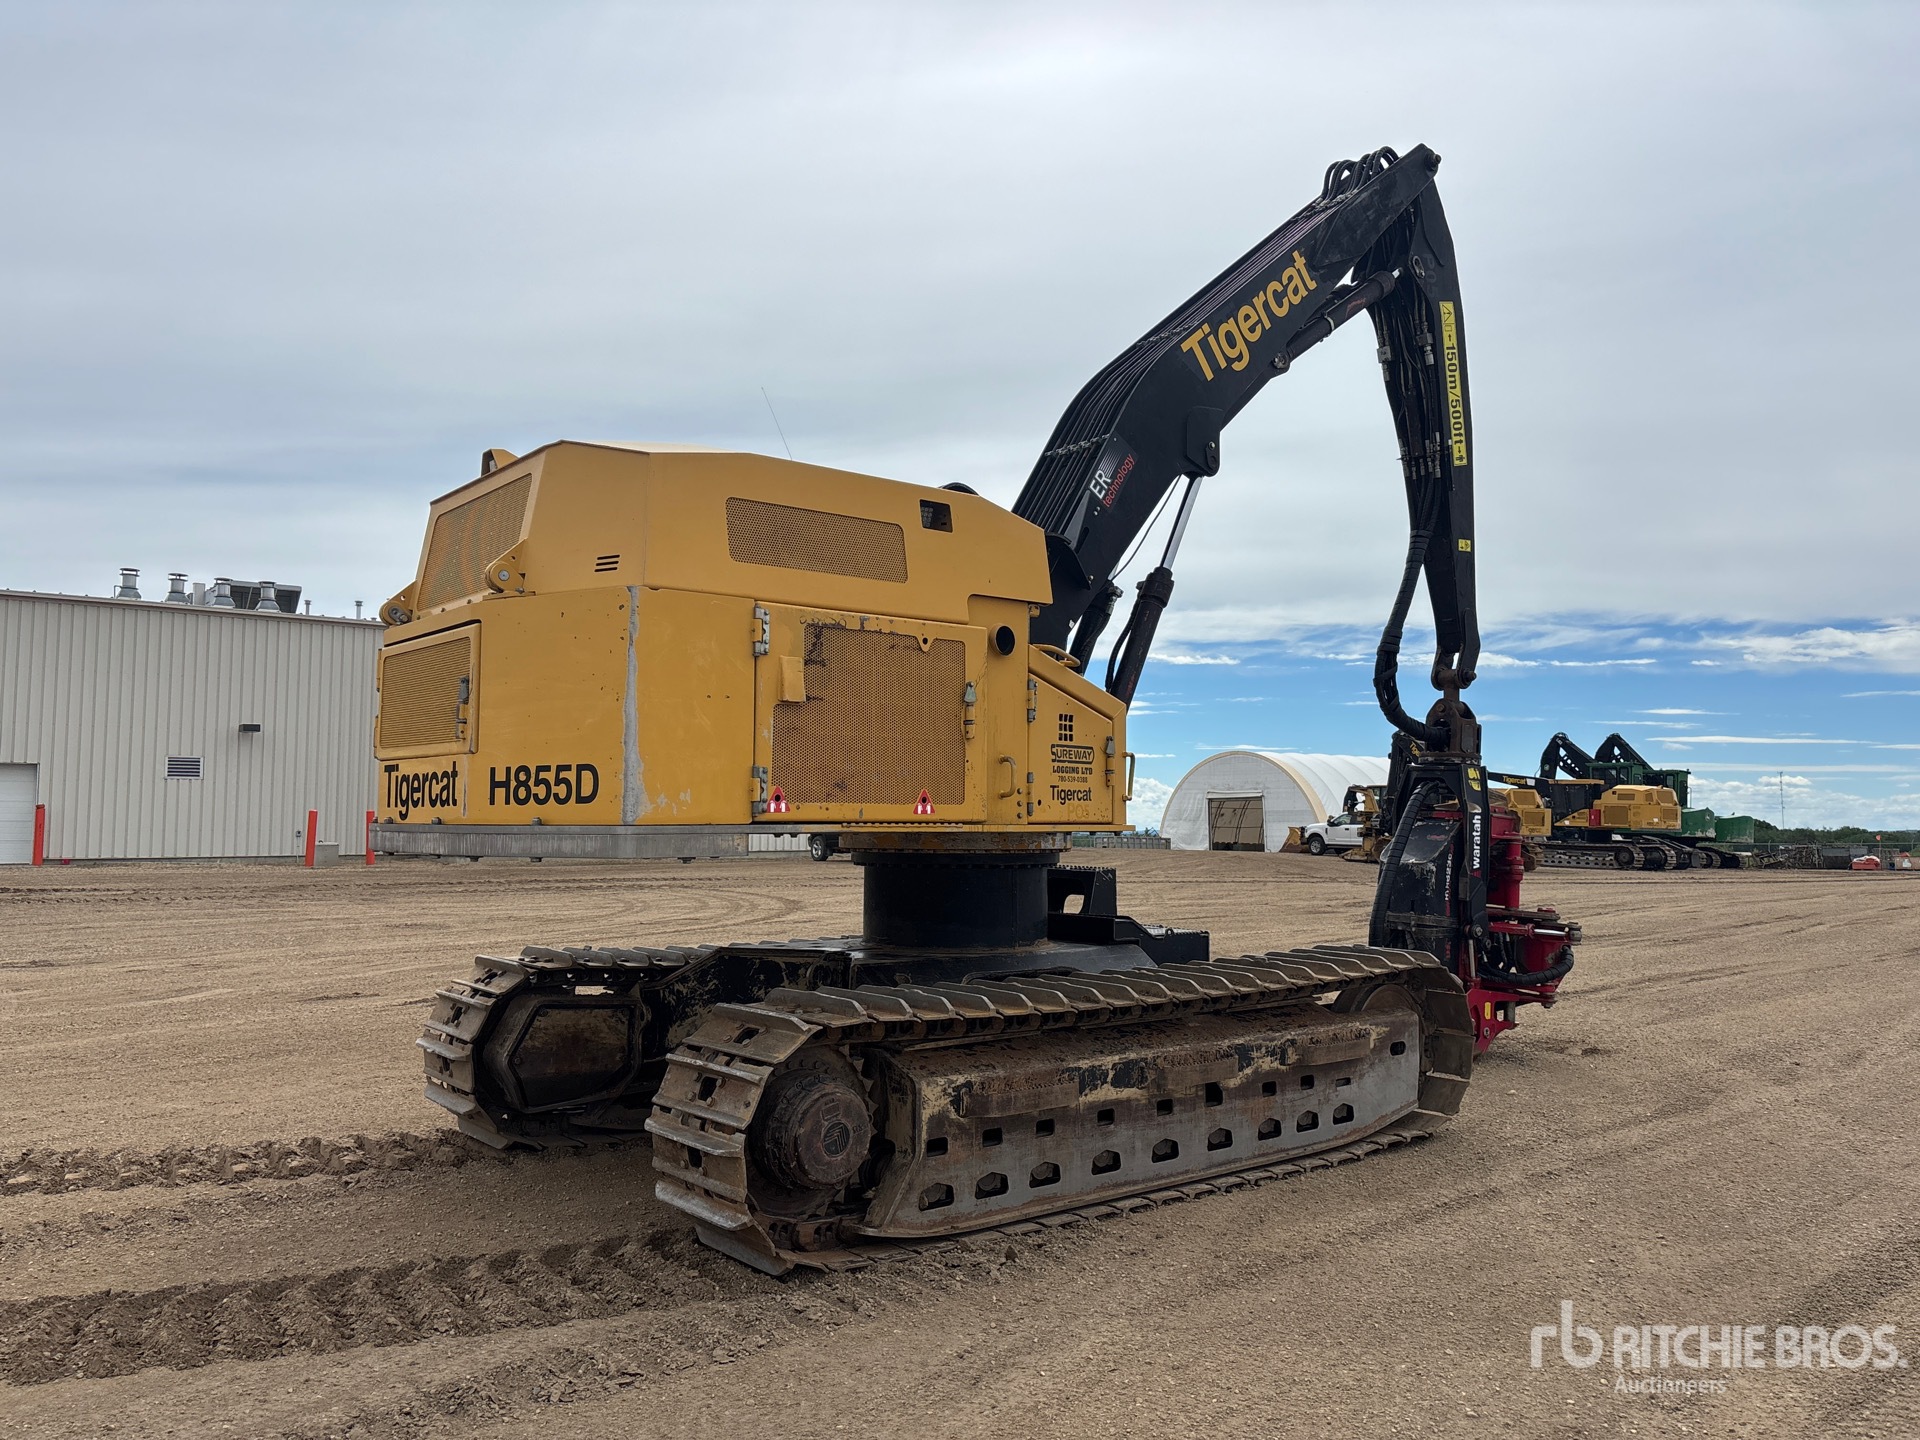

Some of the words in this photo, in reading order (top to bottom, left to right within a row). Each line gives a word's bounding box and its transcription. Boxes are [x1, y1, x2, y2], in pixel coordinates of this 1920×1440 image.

[1180, 250, 1317, 382] Tigercat
[1445, 342, 1463, 445] 150m/500ft
[1089, 469, 1111, 500] ER
[1102, 453, 1135, 507] technology
[1051, 744, 1093, 763] SUREWAY
[1052, 765, 1080, 775] LOGGING
[1081, 766, 1093, 775] LTD
[384, 761, 458, 821] Tigercat
[489, 763, 599, 806] H855D
[1050, 785, 1092, 805] Tigercat
[1502, 775, 1526, 785] Tigercat
[1472, 814, 1482, 869] waratah
